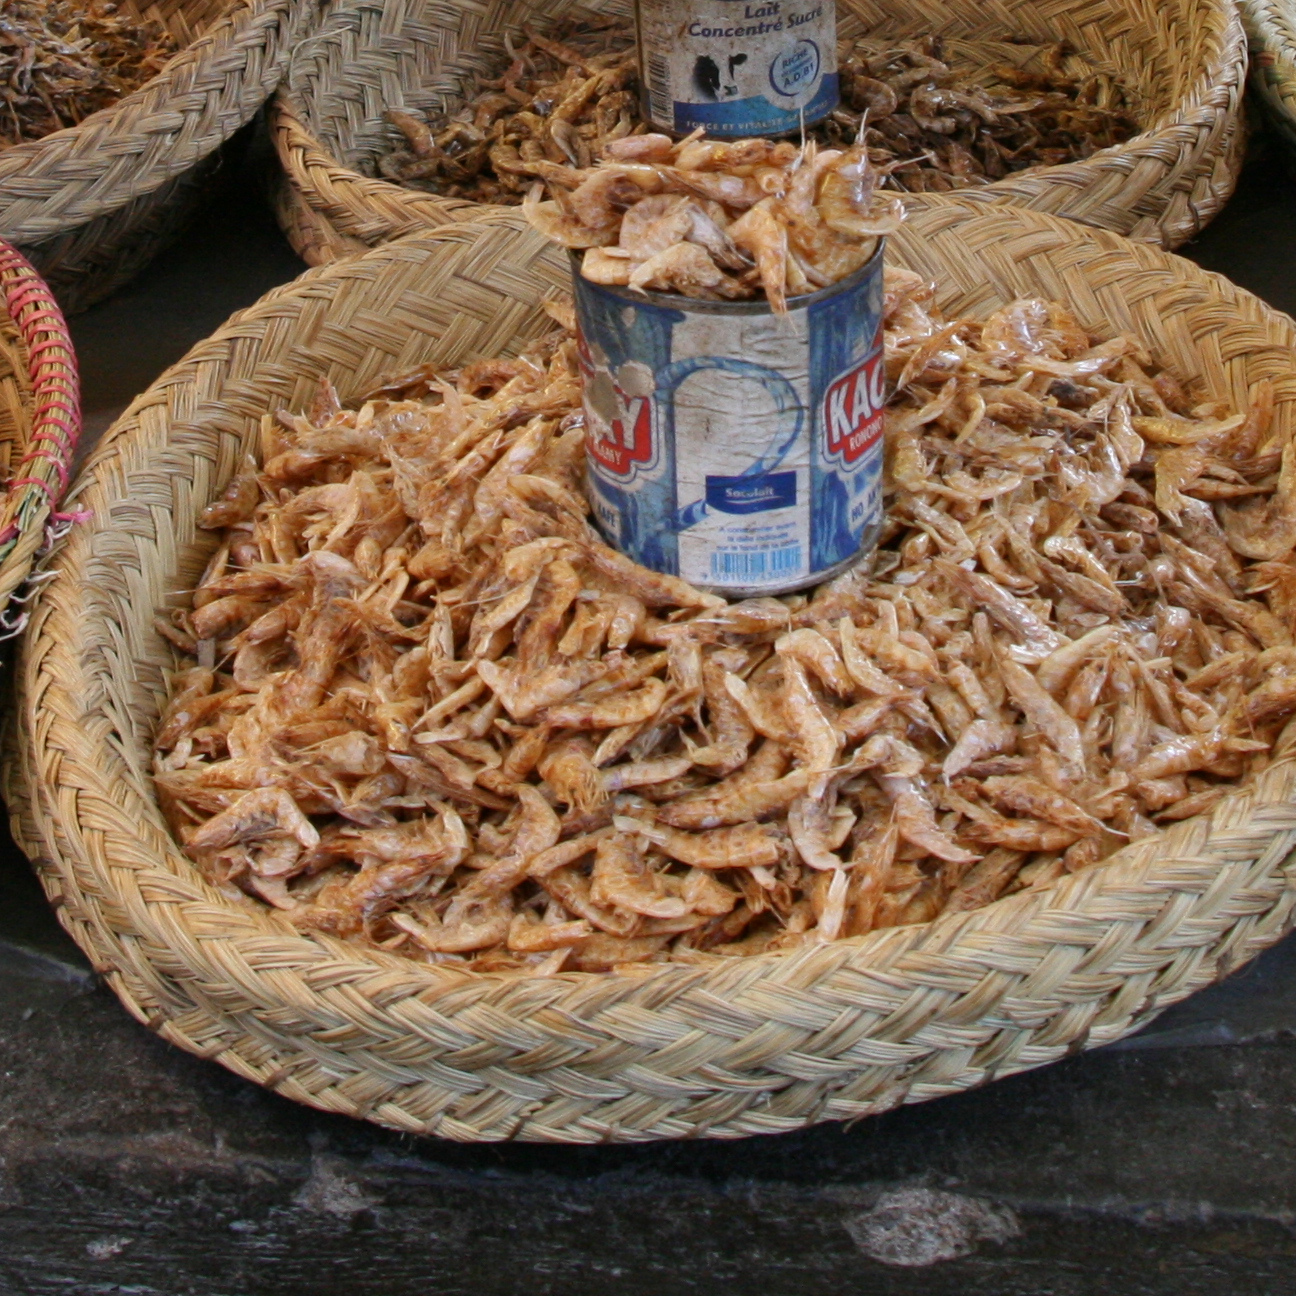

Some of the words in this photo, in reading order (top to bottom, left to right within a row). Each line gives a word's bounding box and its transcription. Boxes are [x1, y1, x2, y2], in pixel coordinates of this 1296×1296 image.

[688, 17, 783, 38] Concentré
[787, 2, 824, 29] Sucré
[744, 2, 781, 20] Lait
